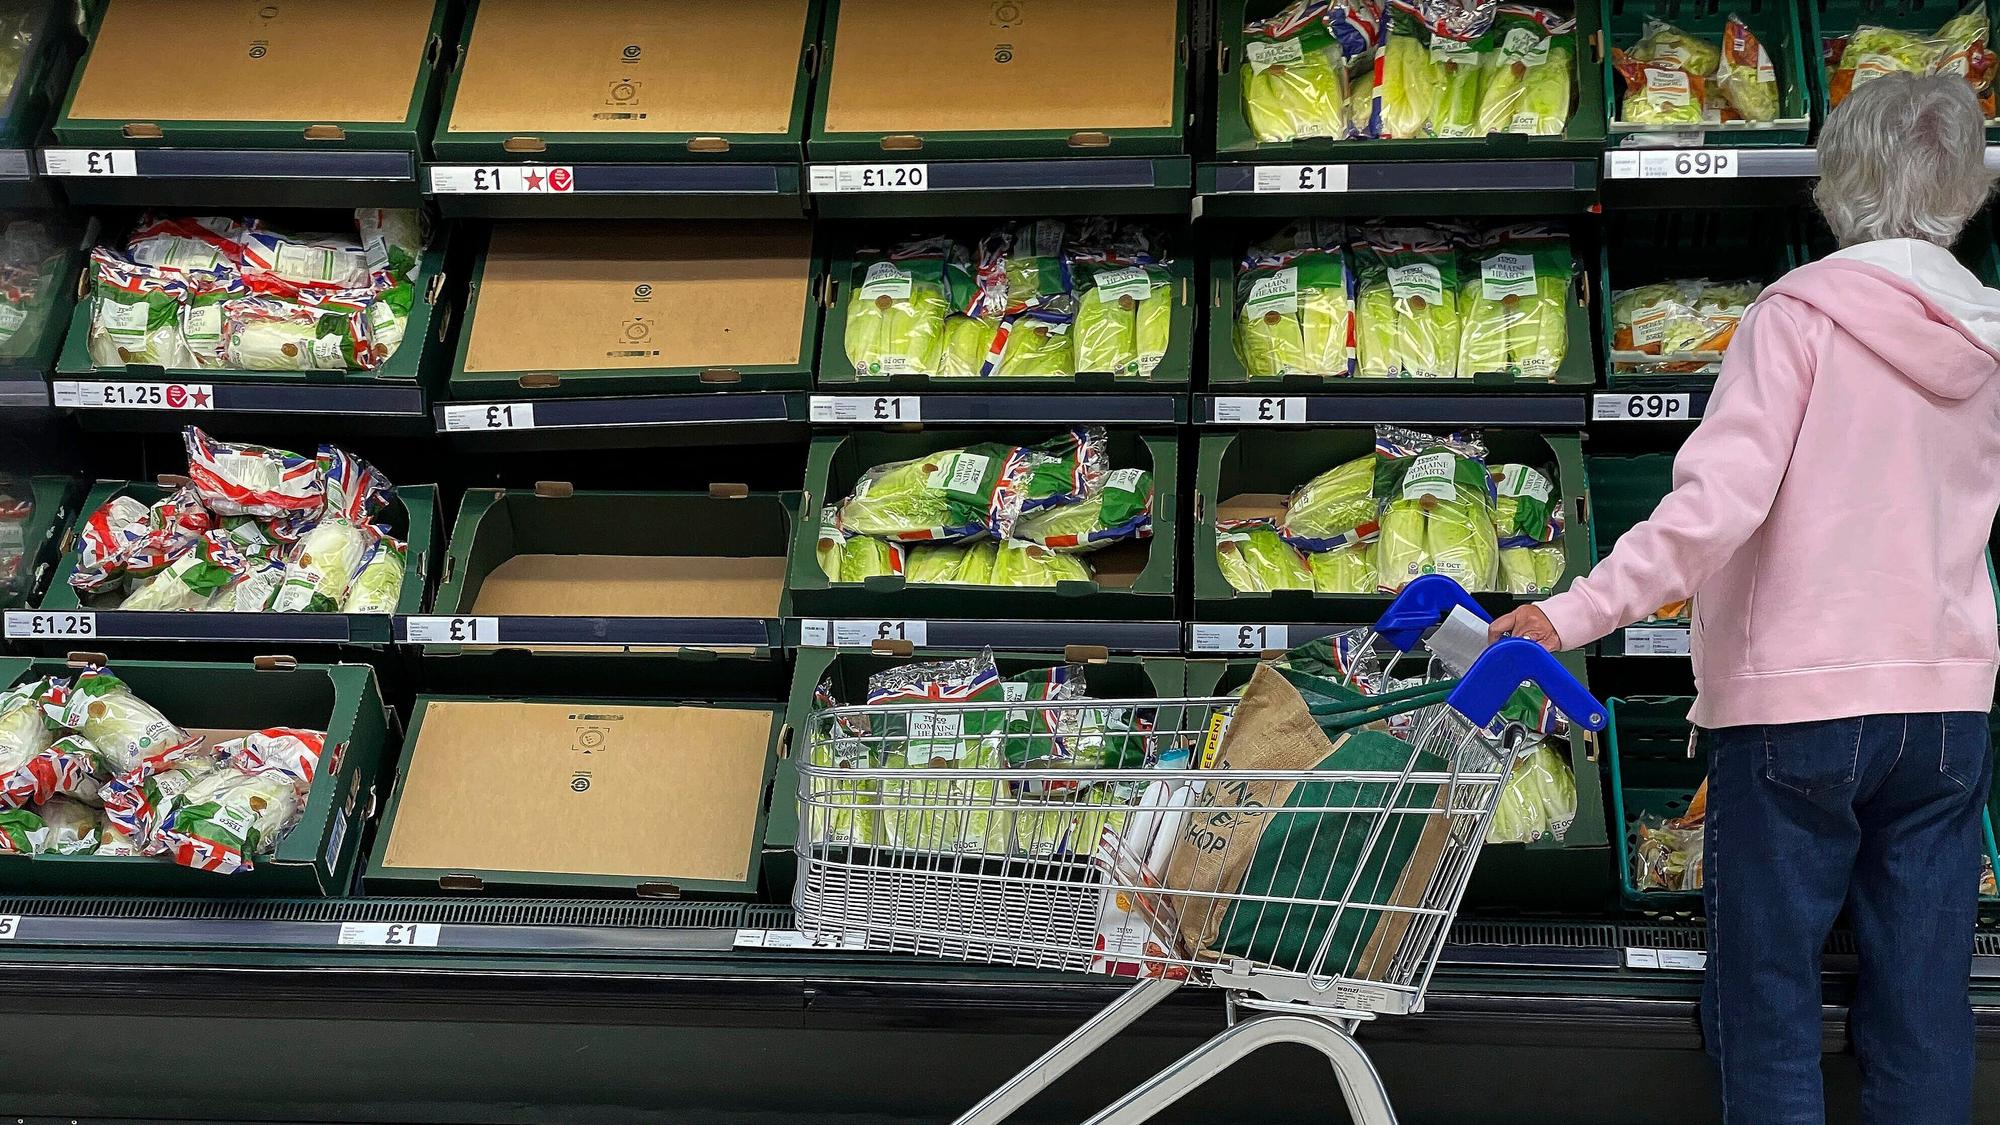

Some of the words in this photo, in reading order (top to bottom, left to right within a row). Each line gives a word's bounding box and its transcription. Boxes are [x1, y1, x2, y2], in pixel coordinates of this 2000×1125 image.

[87, 151, 114, 174] £1
[1675, 152, 1728, 174] 69p
[474, 168, 501, 190] £1
[863, 168, 922, 187] £1.20
[1299, 167, 1327, 189] £1
[1492, 270, 1525, 278] HEARTS
[104, 385, 161, 404] £1.25
[486, 405, 514, 427] £1
[874, 398, 901, 419] £1
[1259, 398, 1286, 420] £1
[1627, 395, 1680, 418] 69p
[1418, 455, 1439, 465] TESCO
[1412, 469, 1445, 479] HEARTS
[32, 616, 92, 634] £1.25
[450, 618, 477, 641] £1
[878, 621, 905, 640] £1
[1238, 625, 1267, 648] £1
[385, 924, 418, 944] £1
[1337, 986, 1360, 994] wanzl
